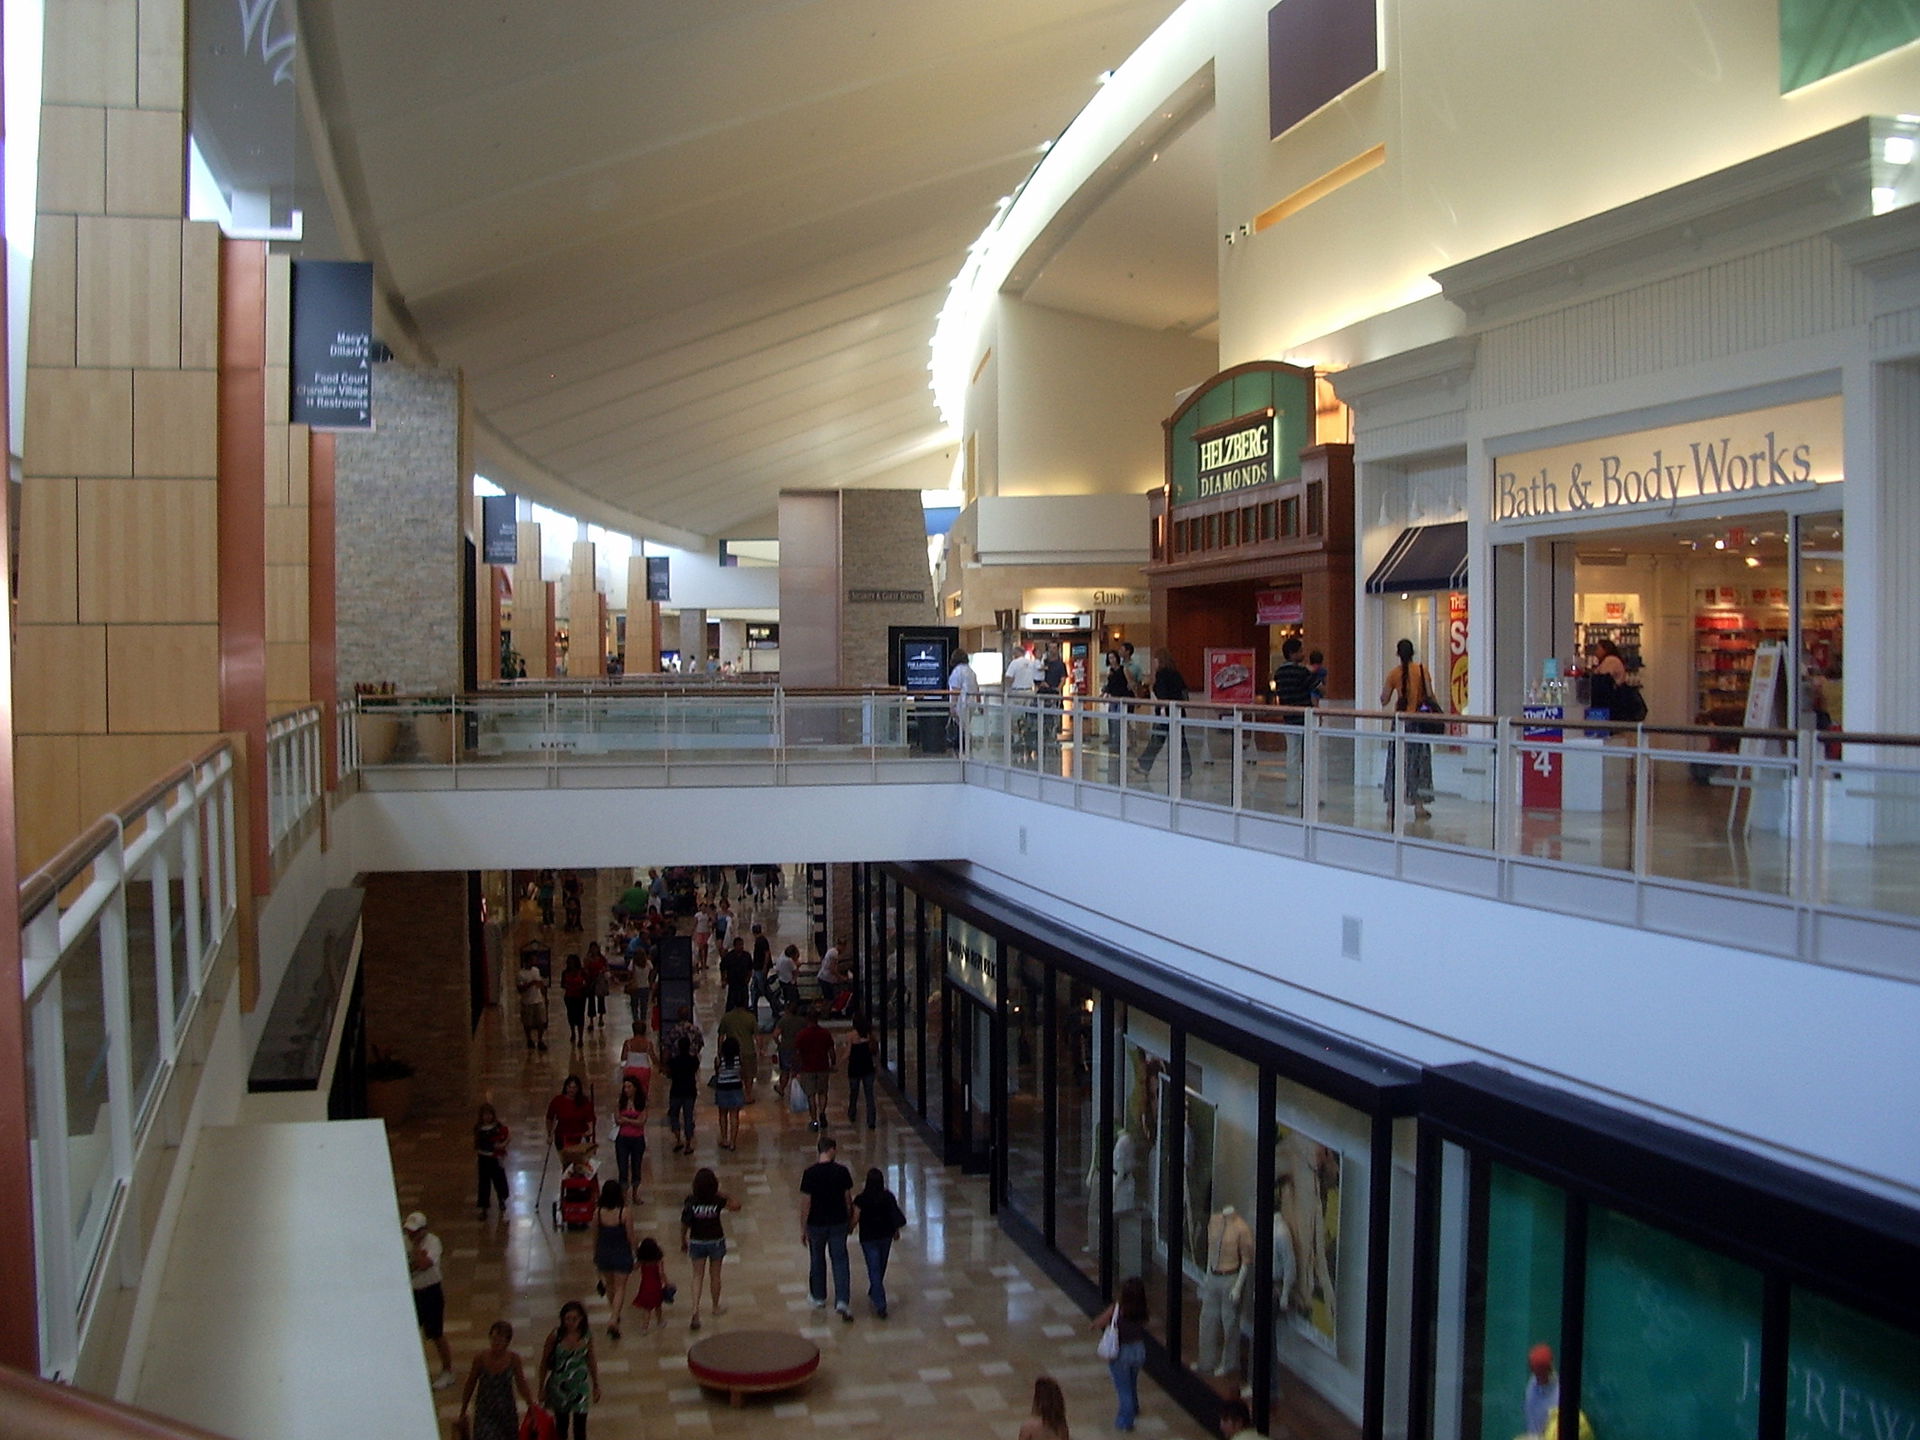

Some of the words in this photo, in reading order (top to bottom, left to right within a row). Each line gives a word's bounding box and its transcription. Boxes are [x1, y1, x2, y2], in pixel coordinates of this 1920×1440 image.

[337, 332, 369, 346] Macy's
[330, 345, 369, 357] Dillard's
[314, 372, 339, 384] Food
[341, 372, 368, 384] Court
[339, 385, 368, 399] Village
[317, 397, 368, 409] Restrooms
[1200, 425, 1269, 472] HELZBERG
[1200, 462, 1268, 498] DIAMONDS
[1498, 468, 1558, 520] Bath
[1568, 462, 1595, 512] &
[1600, 450, 1685, 518] Body
[1689, 431, 1812, 496] Works
